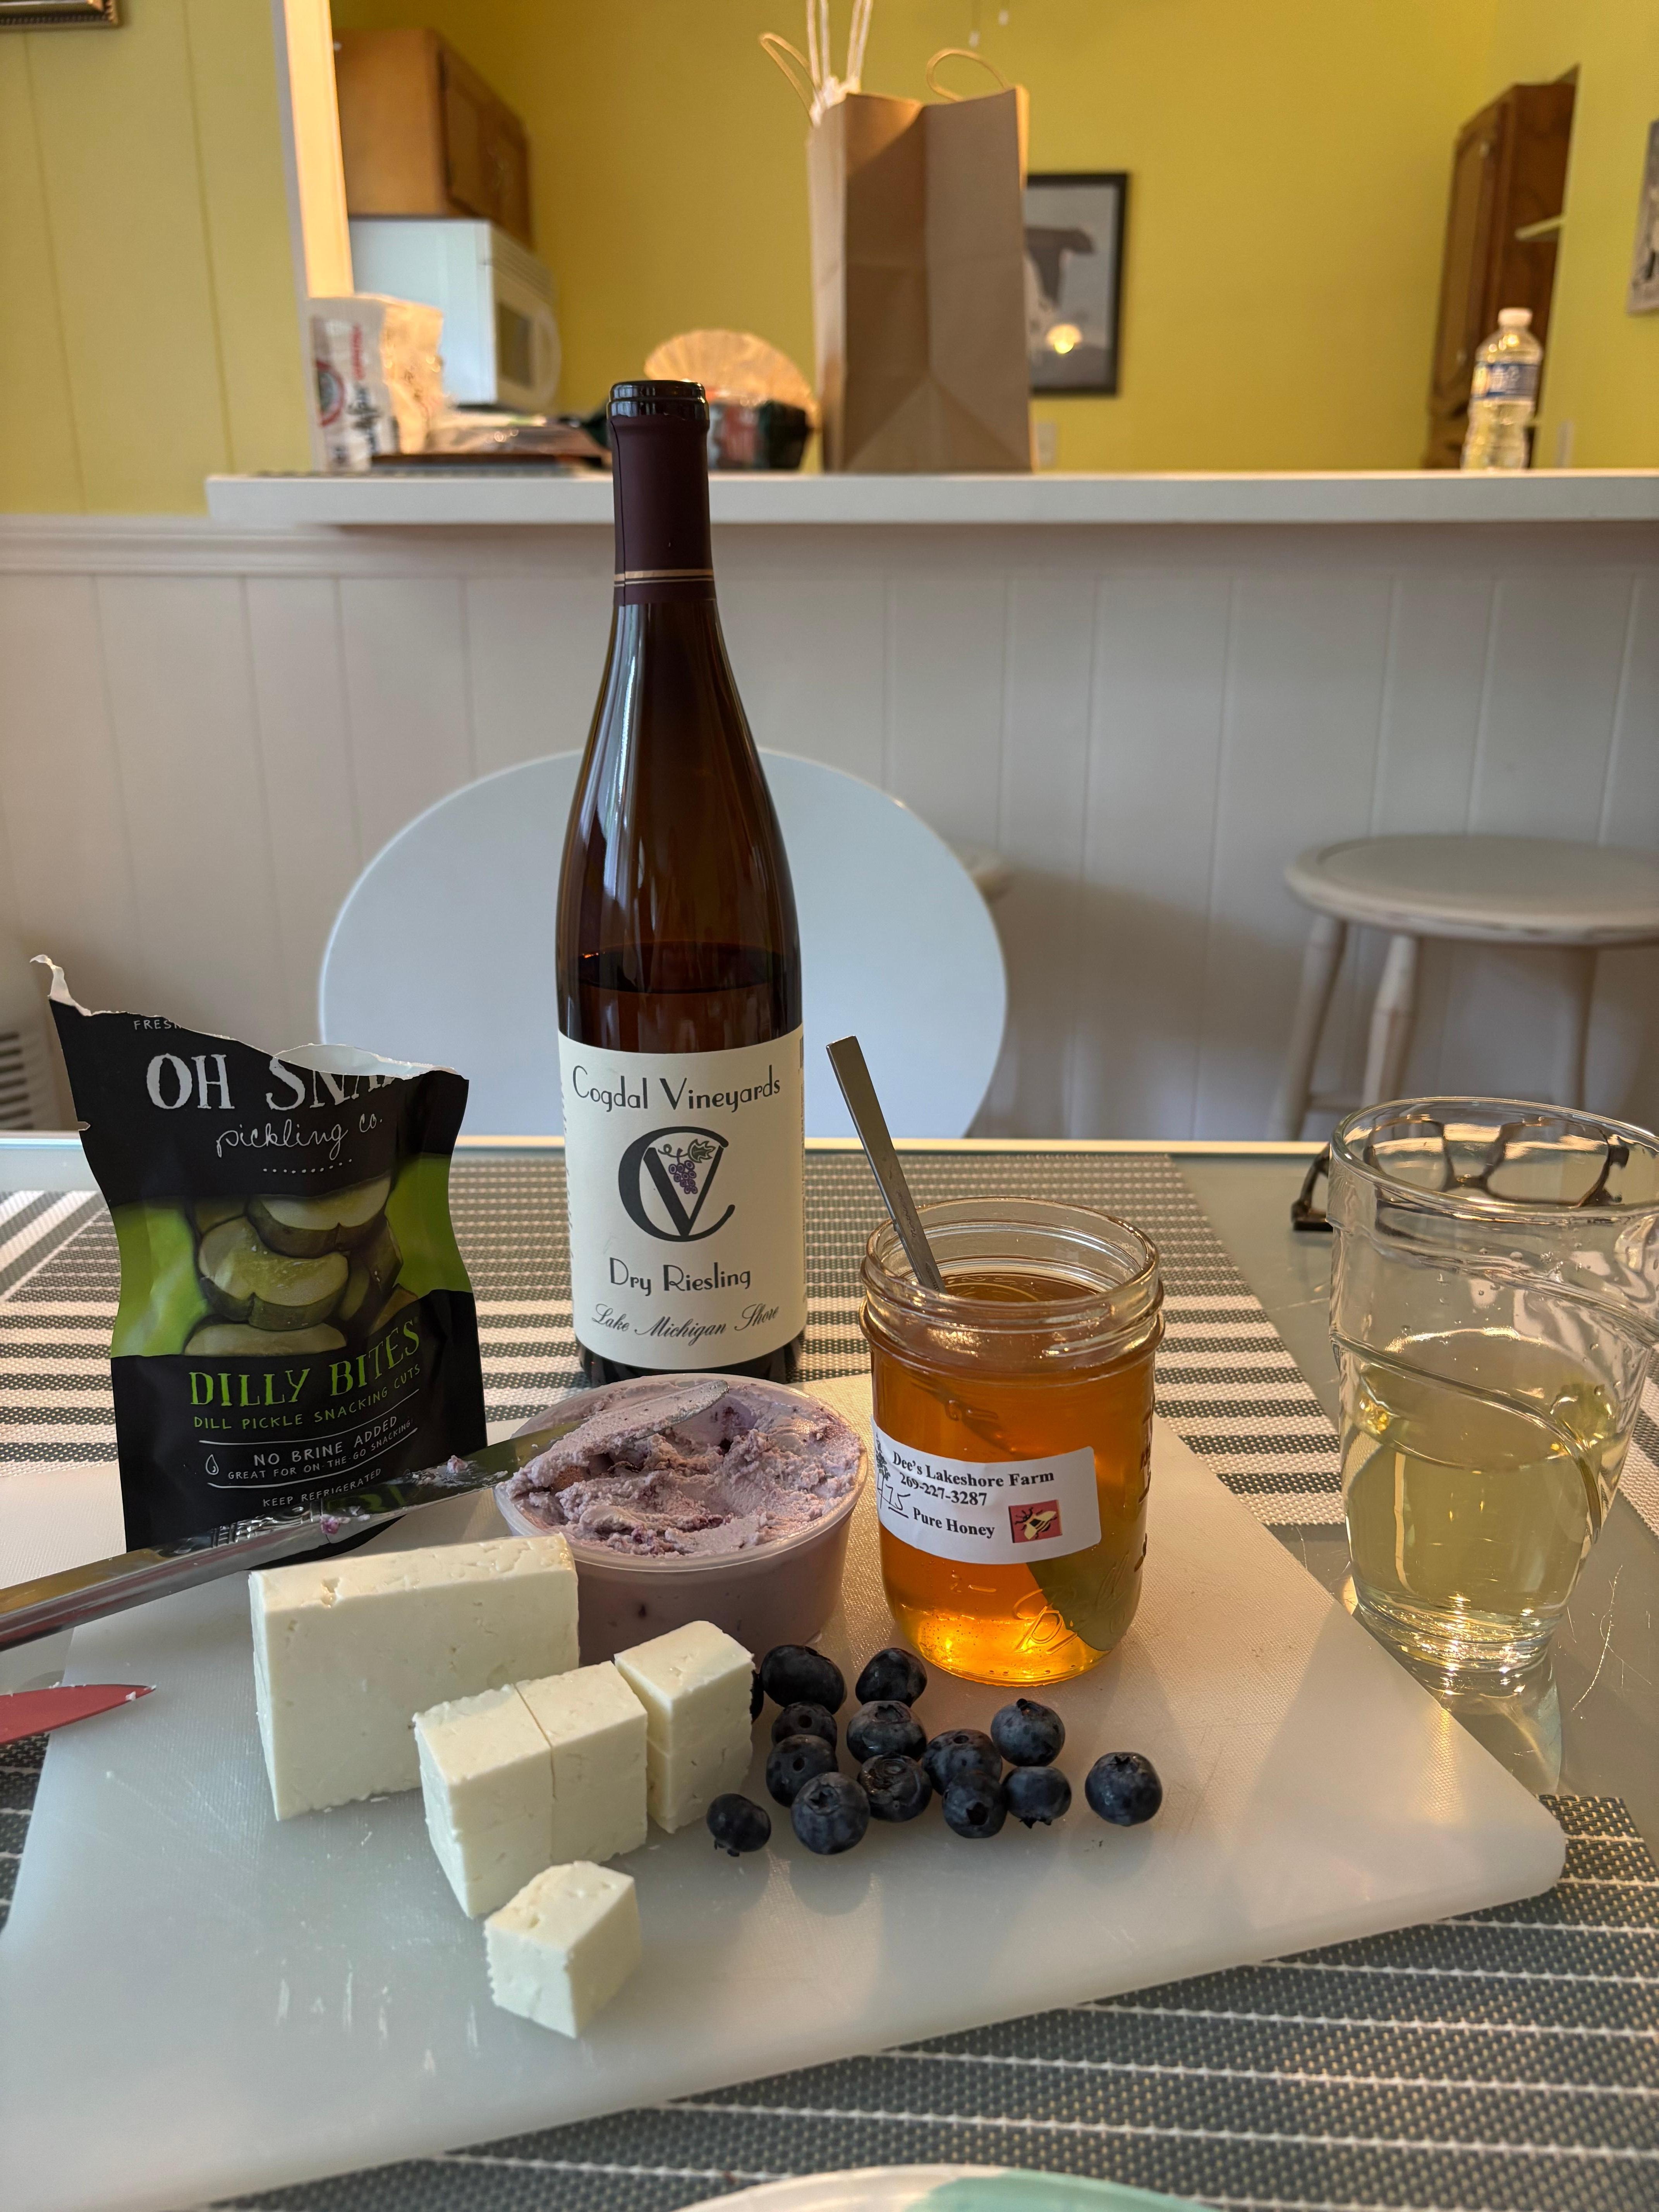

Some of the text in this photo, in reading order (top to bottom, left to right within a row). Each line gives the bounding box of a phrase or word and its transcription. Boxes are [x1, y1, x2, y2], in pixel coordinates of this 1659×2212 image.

[146, 1053, 235, 1109] OH
[572, 1064, 781, 1113] Cogdal Vineyards
[216, 1113, 383, 1161] pickling co.
[610, 1257, 750, 1296] Dry Riesling
[592, 1303, 780, 1346] Lake Michigan Shore
[188, 1319, 420, 1407] DILLY BITES
[194, 1364, 421, 1430] DILL PICKLE SNACKING CUTS
[254, 1416, 397, 1467] NO BRINE ADDED
[228, 1470, 266, 1480] GREAT
[273, 1467, 297, 1477] FOR
[263, 1467, 382, 1508] KEEP REFRIGERATED
[893, 1451, 1054, 1487] Dee's Lakeshore Farm
[899, 1472, 987, 1506] 269-227-3287
[912, 1506, 995, 1539] Pure Honey
